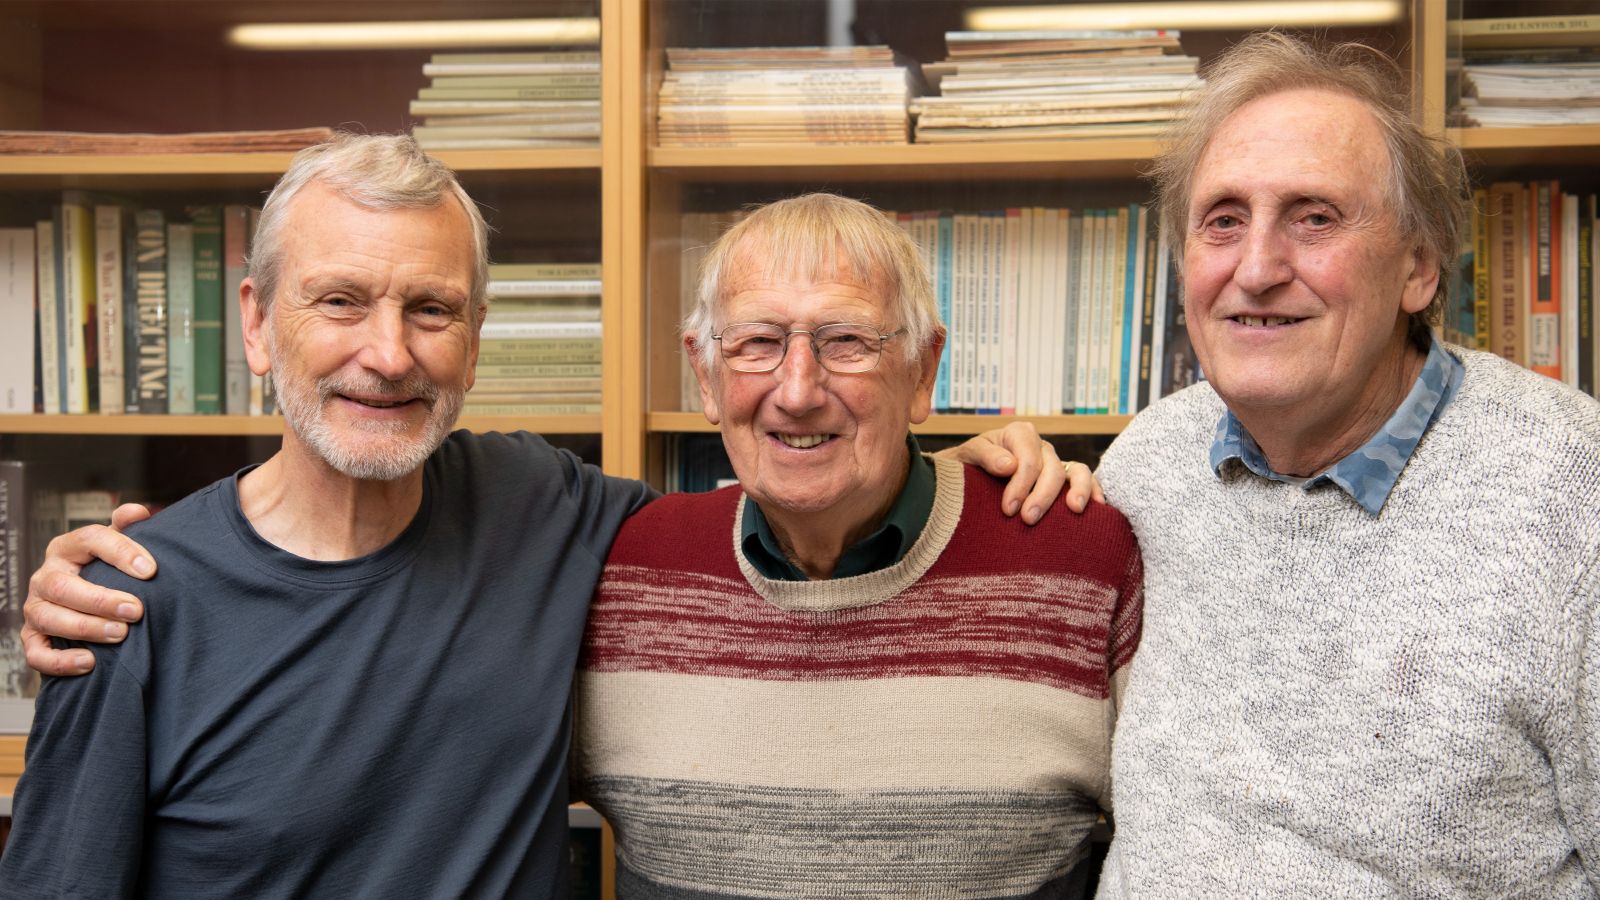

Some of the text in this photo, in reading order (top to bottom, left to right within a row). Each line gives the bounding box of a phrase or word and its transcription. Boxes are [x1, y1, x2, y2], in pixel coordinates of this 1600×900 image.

[1477, 272, 1488, 301] LOOK
[137, 229, 168, 400] ON DIRECTING
[1477, 304, 1488, 332] BACK
